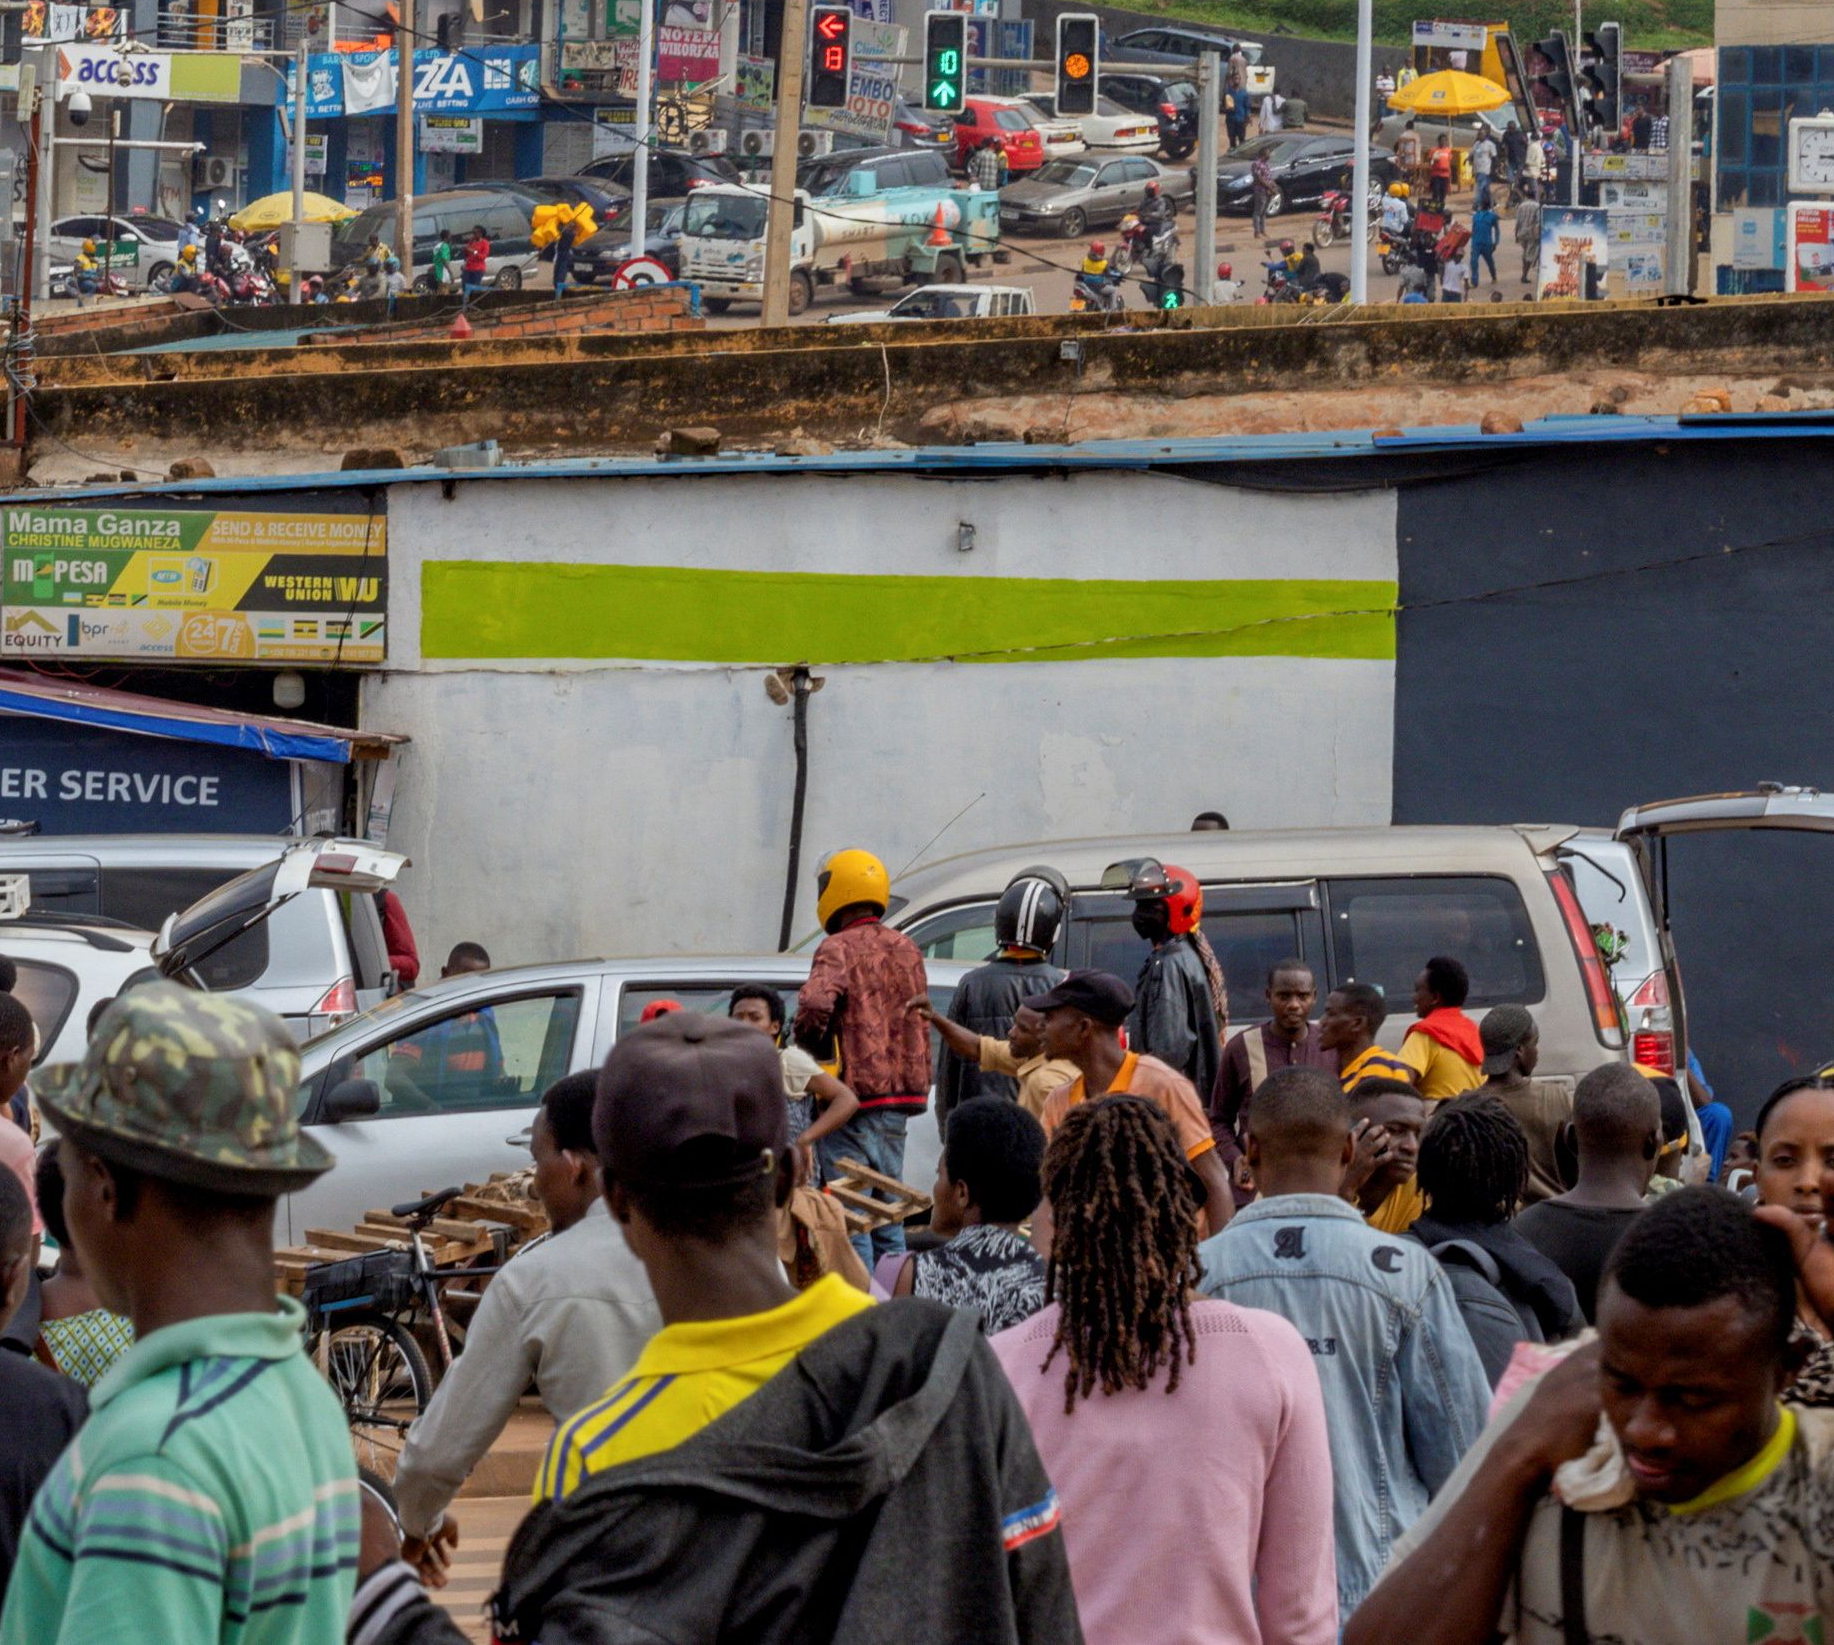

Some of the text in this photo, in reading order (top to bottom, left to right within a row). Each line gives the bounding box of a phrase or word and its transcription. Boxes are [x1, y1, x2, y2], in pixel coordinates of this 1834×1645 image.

[659, 28, 720, 45] NOTERI
[940, 50, 958, 74] 10
[78, 57, 161, 86] accss
[436, 99, 469, 109] BETTING
[9, 511, 384, 539] Mama Ganza SEND & RECEIVE MONEY
[9, 533, 181, 550] CHRISTINE MUGWANEZA
[55, 561, 108, 584] PESA
[154, 571, 179, 583] MTN
[264, 575, 332, 589] WESTERN
[335, 576, 380, 602] WU
[157, 598, 208, 609] Mobile Money
[285, 588, 332, 602] UNION
[81, 619, 110, 639] bpr
[191, 625, 215, 640] 24
[218, 619, 236, 652] 7
[4, 634, 63, 647] EQUITY
[139, 642, 174, 652] access
[59, 769, 221, 807] SERVICE
